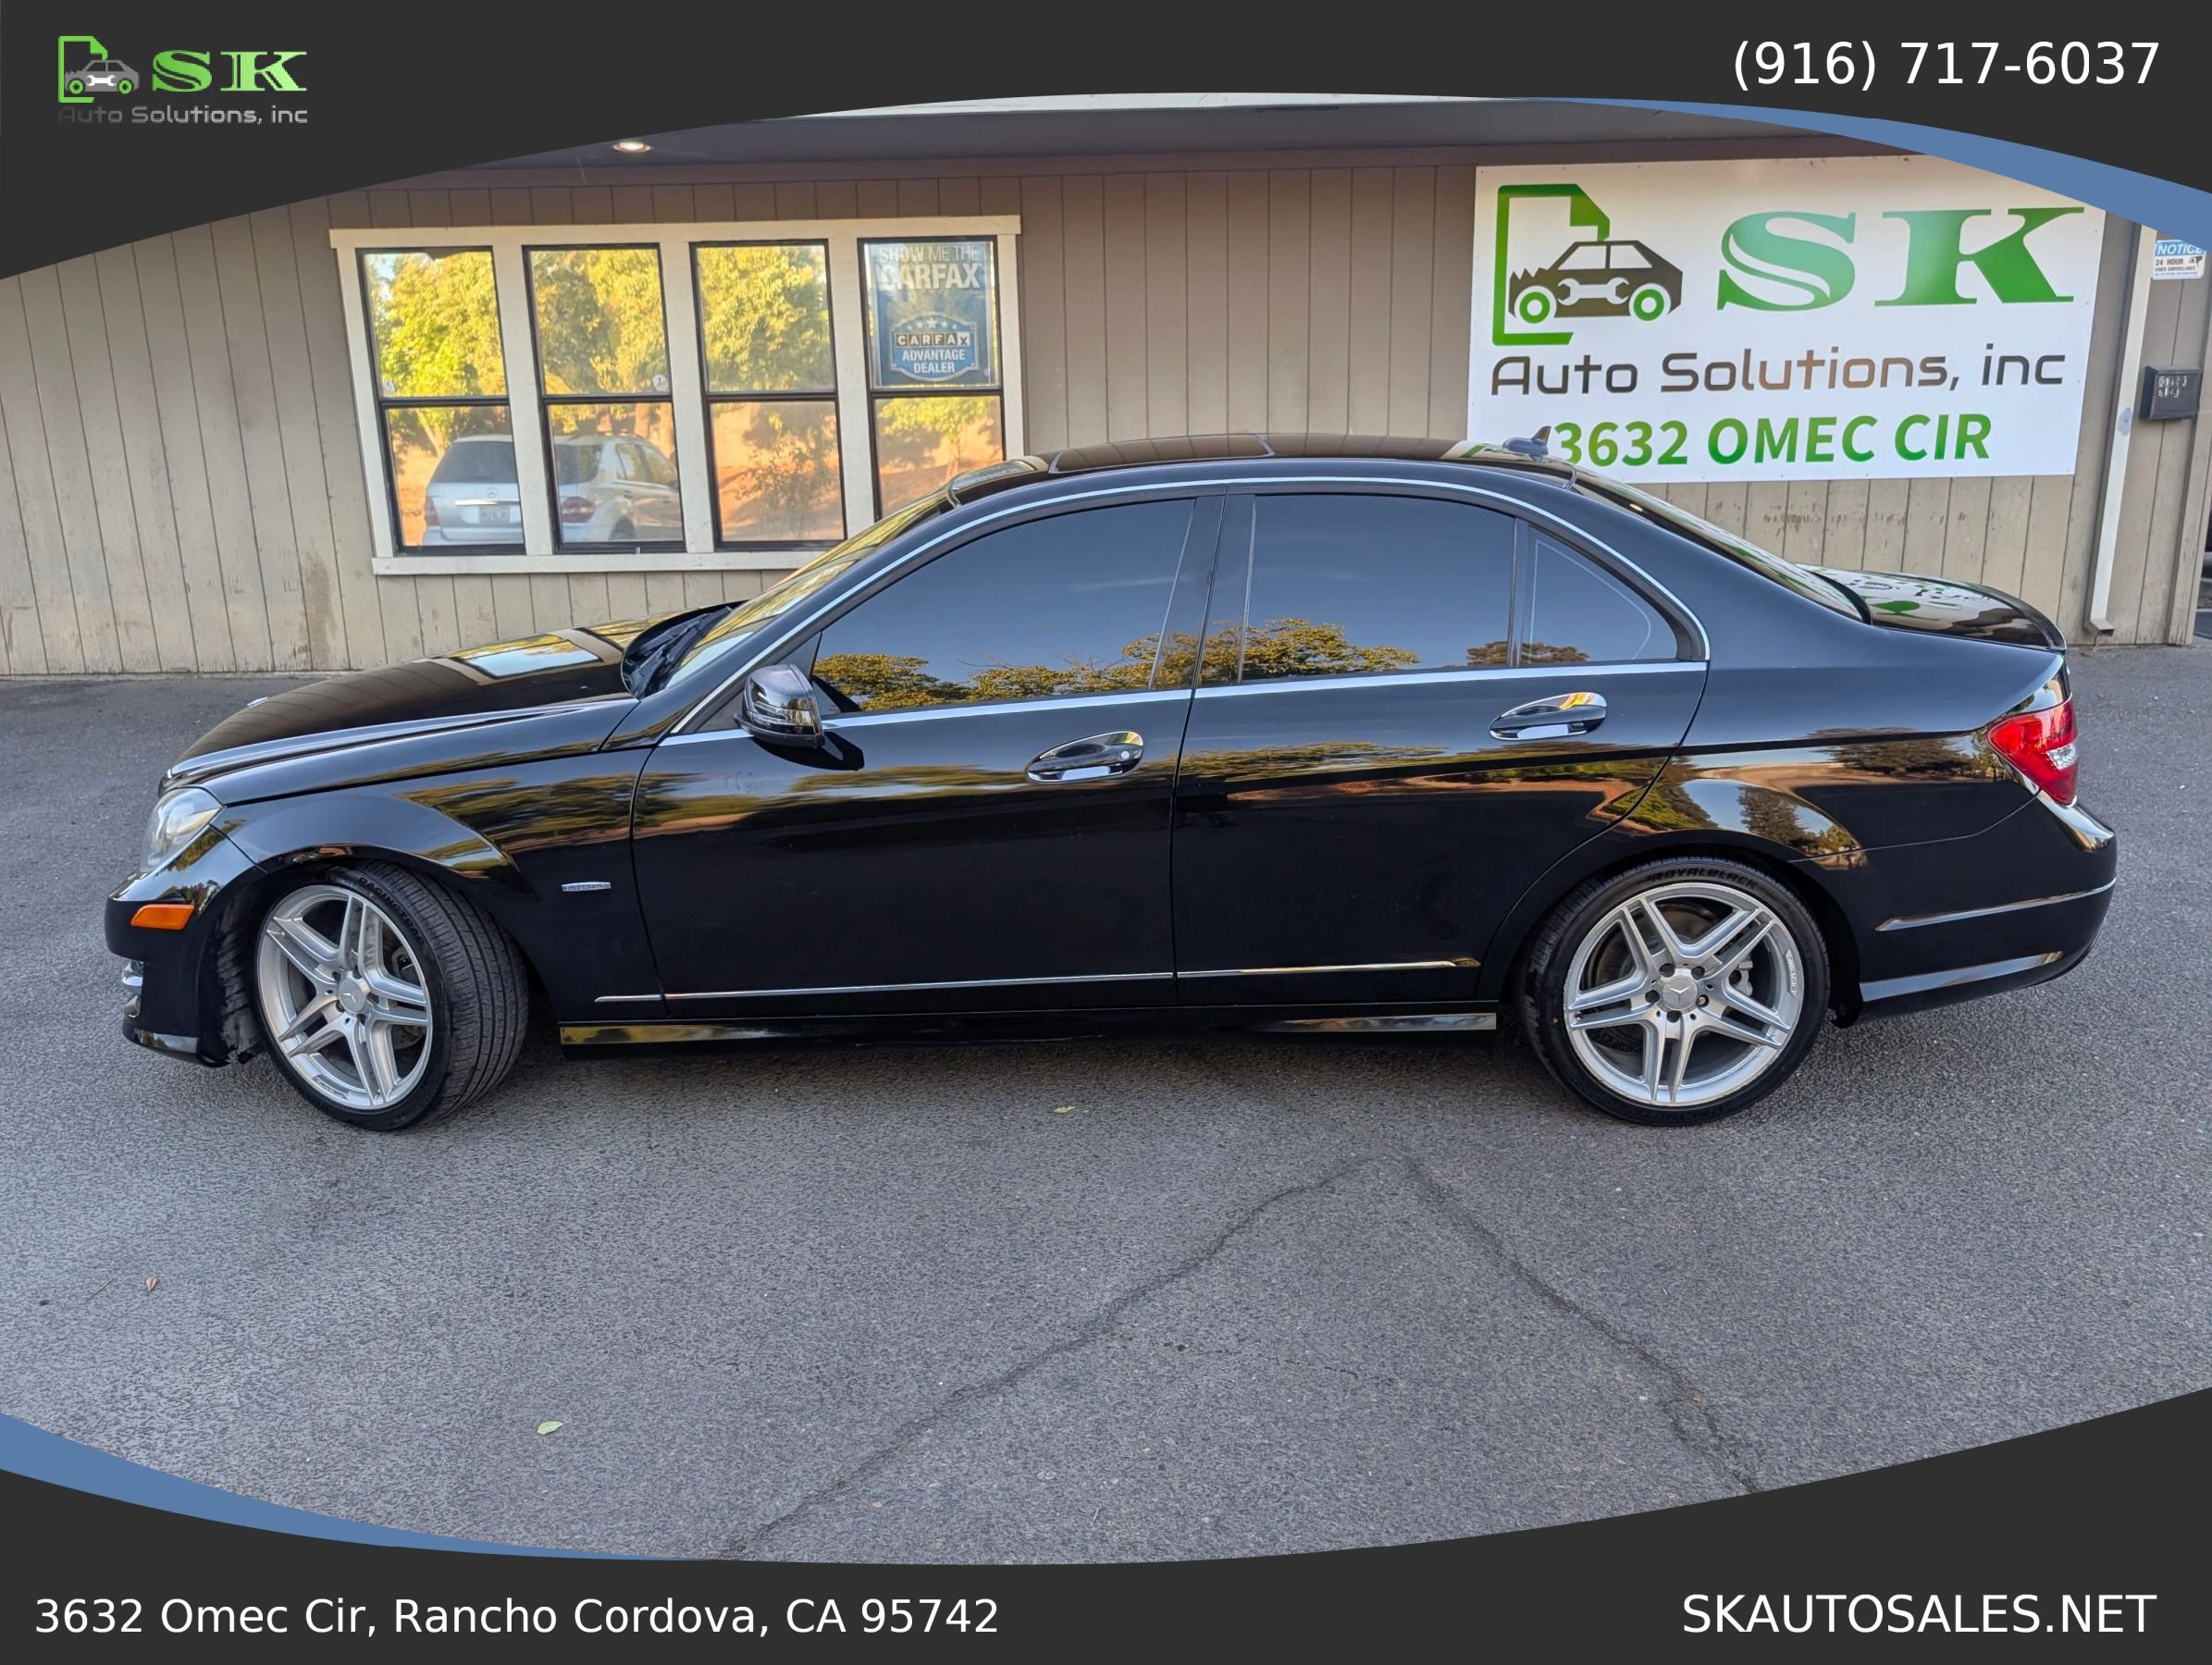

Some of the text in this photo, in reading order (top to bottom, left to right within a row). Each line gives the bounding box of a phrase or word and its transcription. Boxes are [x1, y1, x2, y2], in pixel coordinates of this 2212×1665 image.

[880, 245, 980, 262] SHOW ME THE
[2156, 243, 2203, 255] NOTICE
[1716, 206, 2084, 312] SK
[879, 264, 981, 290] CARFAX
[896, 334, 970, 347] CARFAX
[902, 349, 966, 362] ADVANTAGE
[913, 362, 956, 374] DEALER
[1491, 343, 2066, 396] Auto Solutions, inc
[1554, 413, 1992, 467] 3632 OMEC CIR
